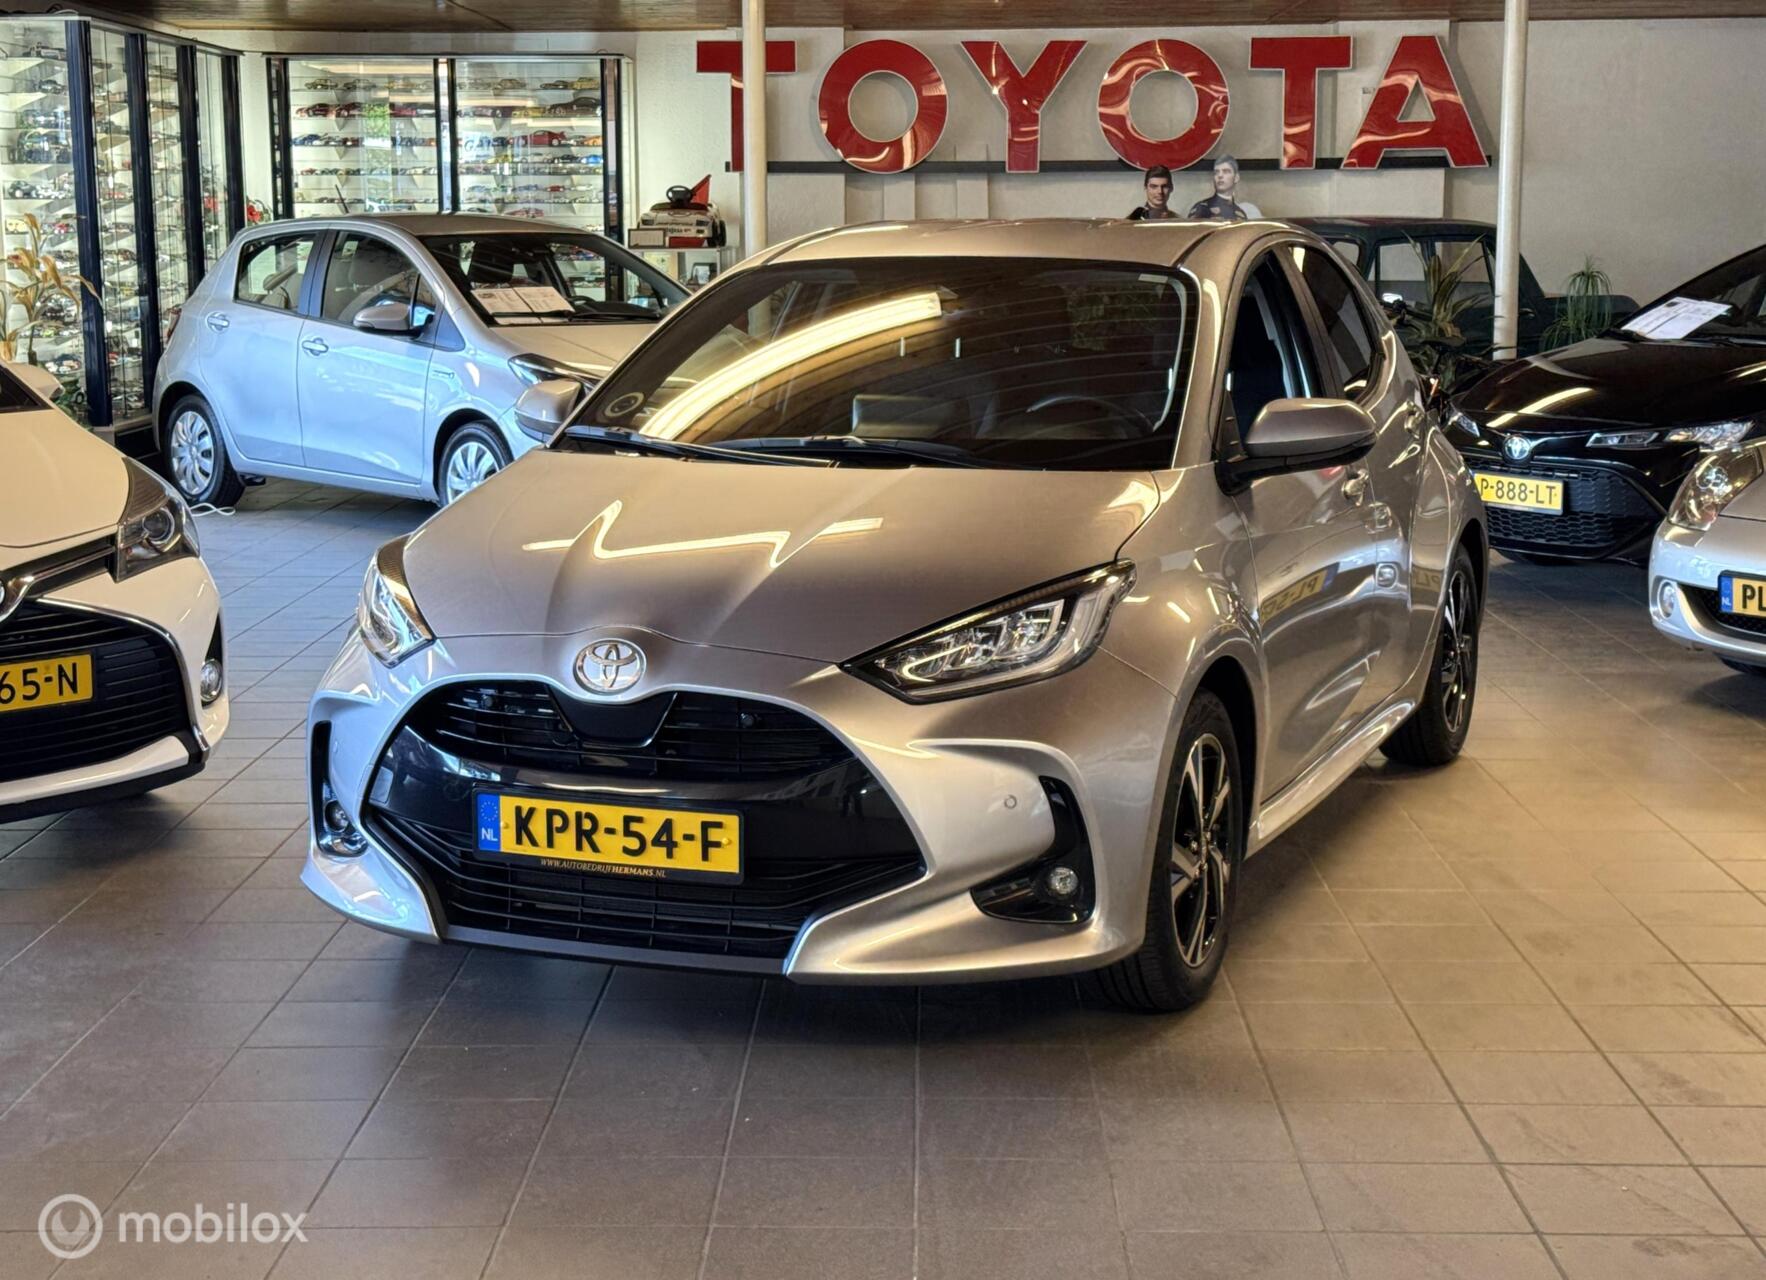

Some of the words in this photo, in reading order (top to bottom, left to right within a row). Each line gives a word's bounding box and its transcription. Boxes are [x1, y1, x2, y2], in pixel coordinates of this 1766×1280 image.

[696, 35, 1490, 173] TOYOTA
[1480, 478, 1556, 505] P-888-LT
[0, 662, 78, 705] 65-N
[481, 827, 498, 842] NL
[514, 805, 724, 862] KPR-54-F
[540, 858, 667, 878] WWW.AUTOBEDRIJFHERMANS.NL
